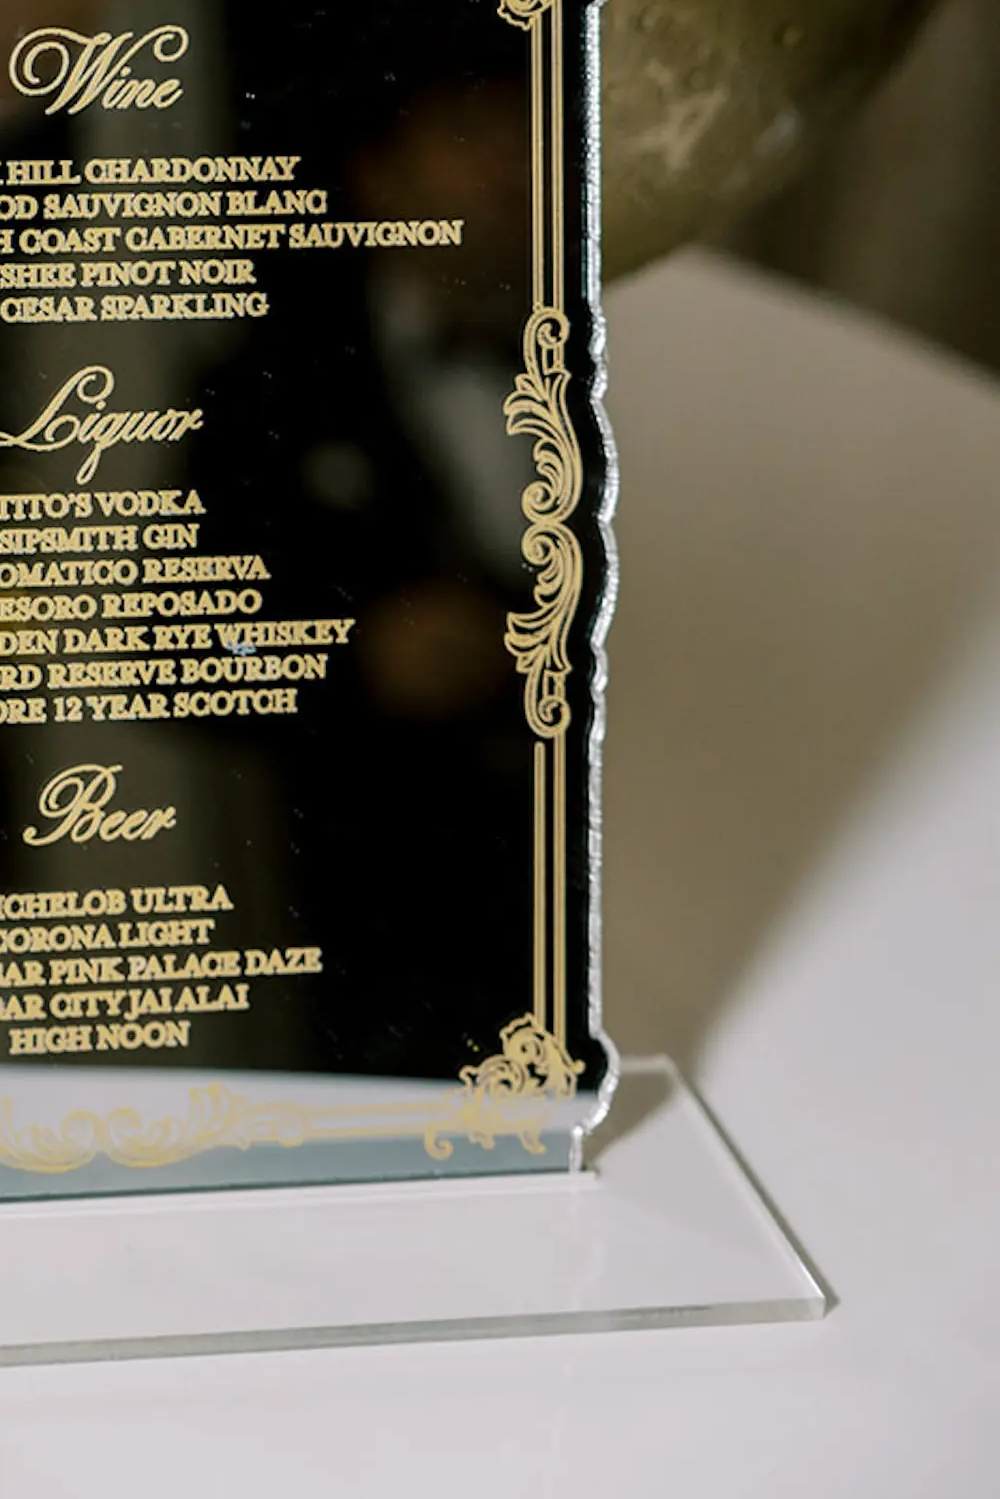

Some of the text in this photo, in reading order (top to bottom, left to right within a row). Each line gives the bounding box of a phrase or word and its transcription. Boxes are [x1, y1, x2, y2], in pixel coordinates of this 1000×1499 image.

[9, 24, 189, 115] Wine
[7, 159, 80, 185] HILL
[84, 156, 300, 184] CHARDONNAY
[44, 191, 223, 220] SAUVIGNON
[226, 190, 327, 216] BLANC
[20, 229, 121, 254] COAST
[125, 225, 284, 252] CABERNET
[289, 220, 463, 248] SAUVIGNON
[80, 261, 176, 286] PINOT
[180, 259, 255, 284] NOIR
[0, 296, 96, 323] CESAR
[100, 292, 267, 320] SPARKLING
[98, 490, 206, 517] VODKA
[144, 524, 199, 550] GIN
[143, 556, 271, 583] RESERVA
[101, 589, 262, 619] REPOSADO
[63, 626, 150, 654] DARK
[153, 624, 213, 651] RYE
[216, 620, 356, 649] WHISKEY
[47, 660, 175, 690] RESERVE
[181, 654, 327, 684] BOURBON
[53, 696, 83, 721] 12
[87, 693, 170, 720] YEAR
[174, 688, 297, 718] SCOTCH
[23, 764, 176, 846] Beer
[132, 885, 234, 912] ULTRA
[119, 919, 215, 947] LIGHT
[50, 958, 128, 985] PINK
[129, 952, 240, 982] PALACE
[245, 947, 322, 975] DAZE
[50, 990, 123, 1020] CITY
[125, 987, 173, 1020] JAI
[173, 984, 249, 1012] ALAI
[9, 1021, 190, 1054] HIGH NOON
